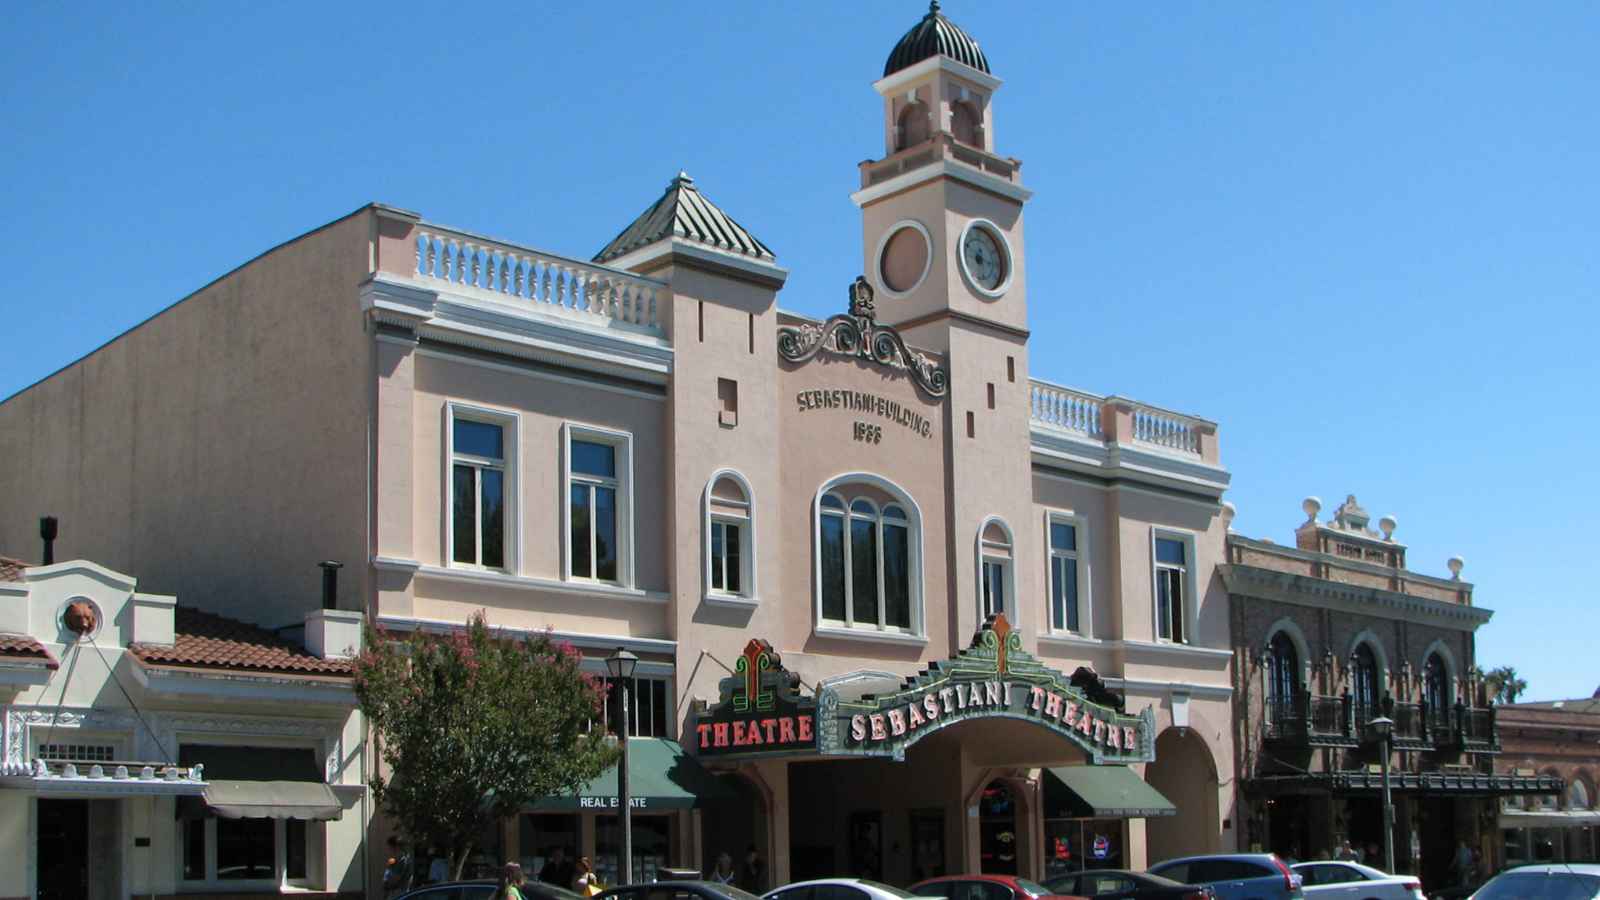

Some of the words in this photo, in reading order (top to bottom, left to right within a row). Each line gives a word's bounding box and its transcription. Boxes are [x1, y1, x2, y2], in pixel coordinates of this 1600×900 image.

[696, 714, 815, 748] THEATRE
[850, 680, 1012, 742] SEBASTIANI
[1030, 686, 1137, 750] THEATRE
[580, 796, 607, 808] REAL
[610, 796, 648, 808] EATE
